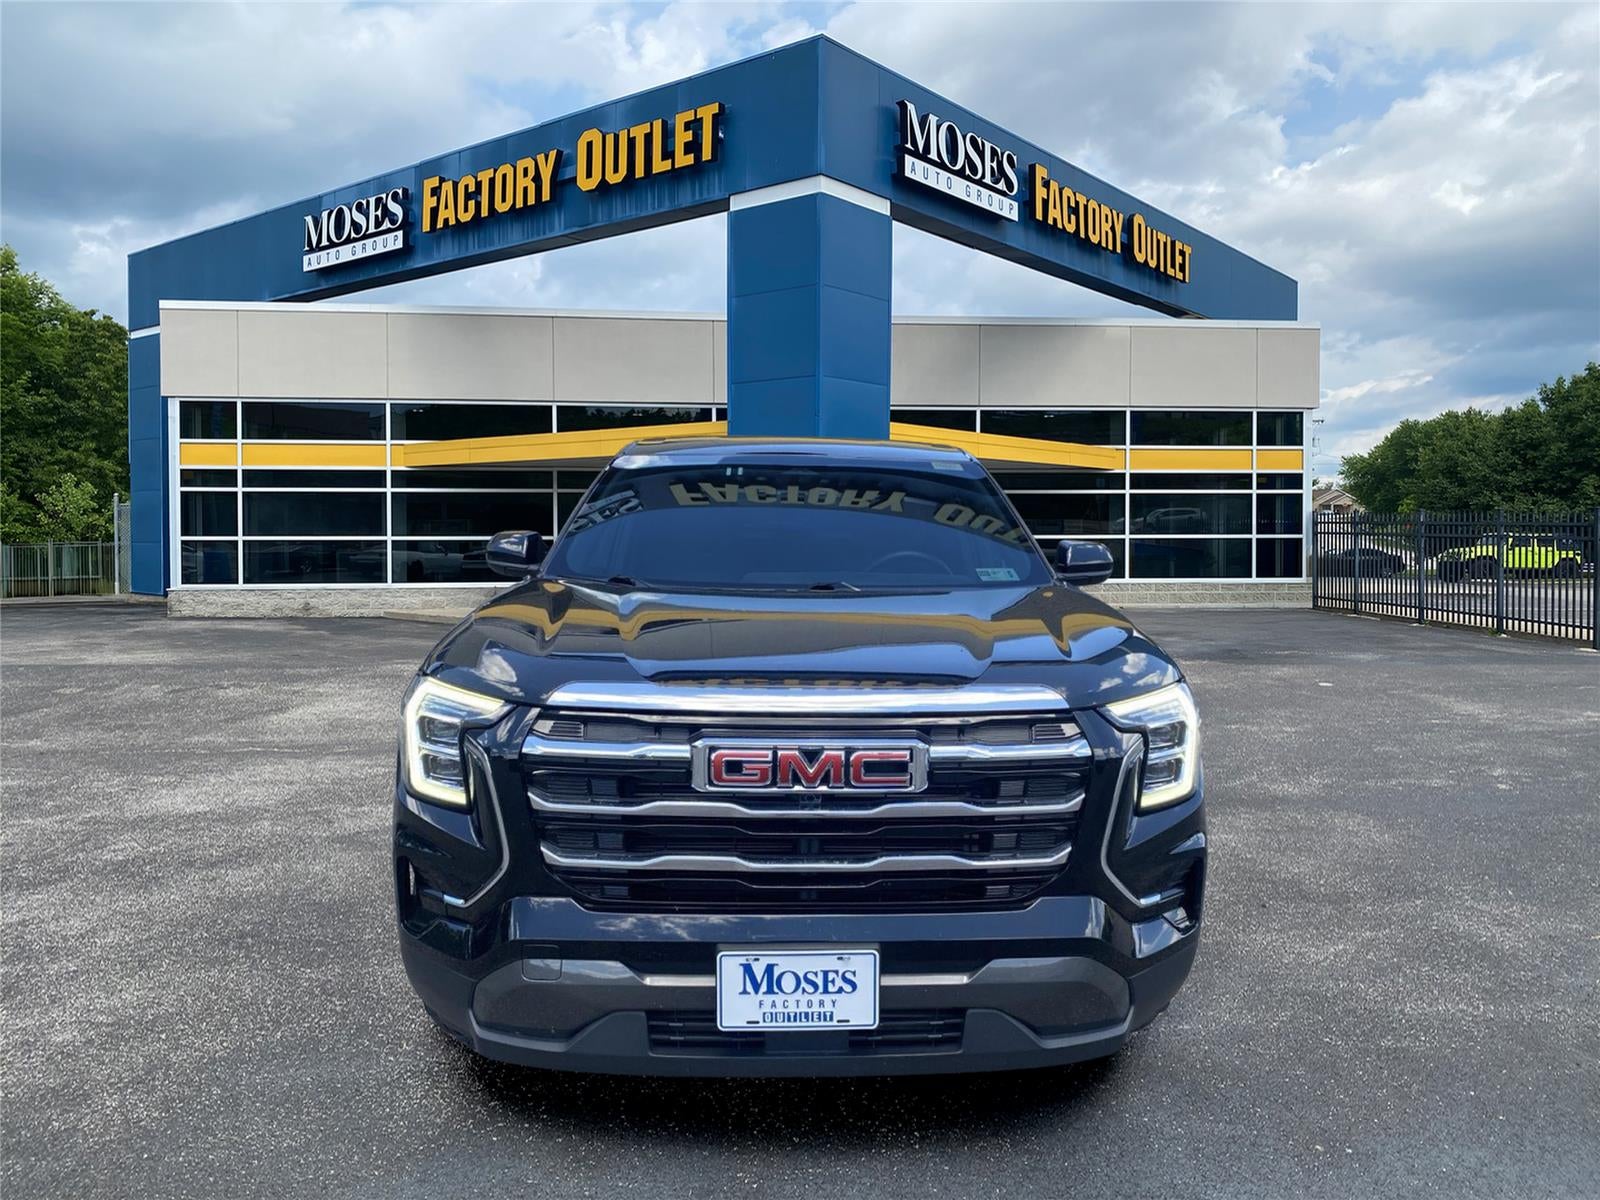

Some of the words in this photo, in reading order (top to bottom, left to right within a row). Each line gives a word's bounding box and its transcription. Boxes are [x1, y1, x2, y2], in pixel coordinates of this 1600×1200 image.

[422, 149, 559, 233] FACTORY
[576, 102, 721, 192] OUTLET
[903, 100, 1019, 196] MOSES
[910, 161, 954, 190] AUTO
[965, 185, 1014, 215] GROUP
[303, 187, 404, 251] MOSES
[1034, 163, 1124, 254] FACTORY
[1132, 213, 1192, 284] OUTLET
[307, 249, 341, 268] AUTO
[351, 234, 400, 257] GROUP
[710, 749, 911, 788] GMC
[738, 962, 858, 995] MOSES
[759, 999, 838, 1009] FACTORY
[762, 1011, 834, 1024] OUTLET
